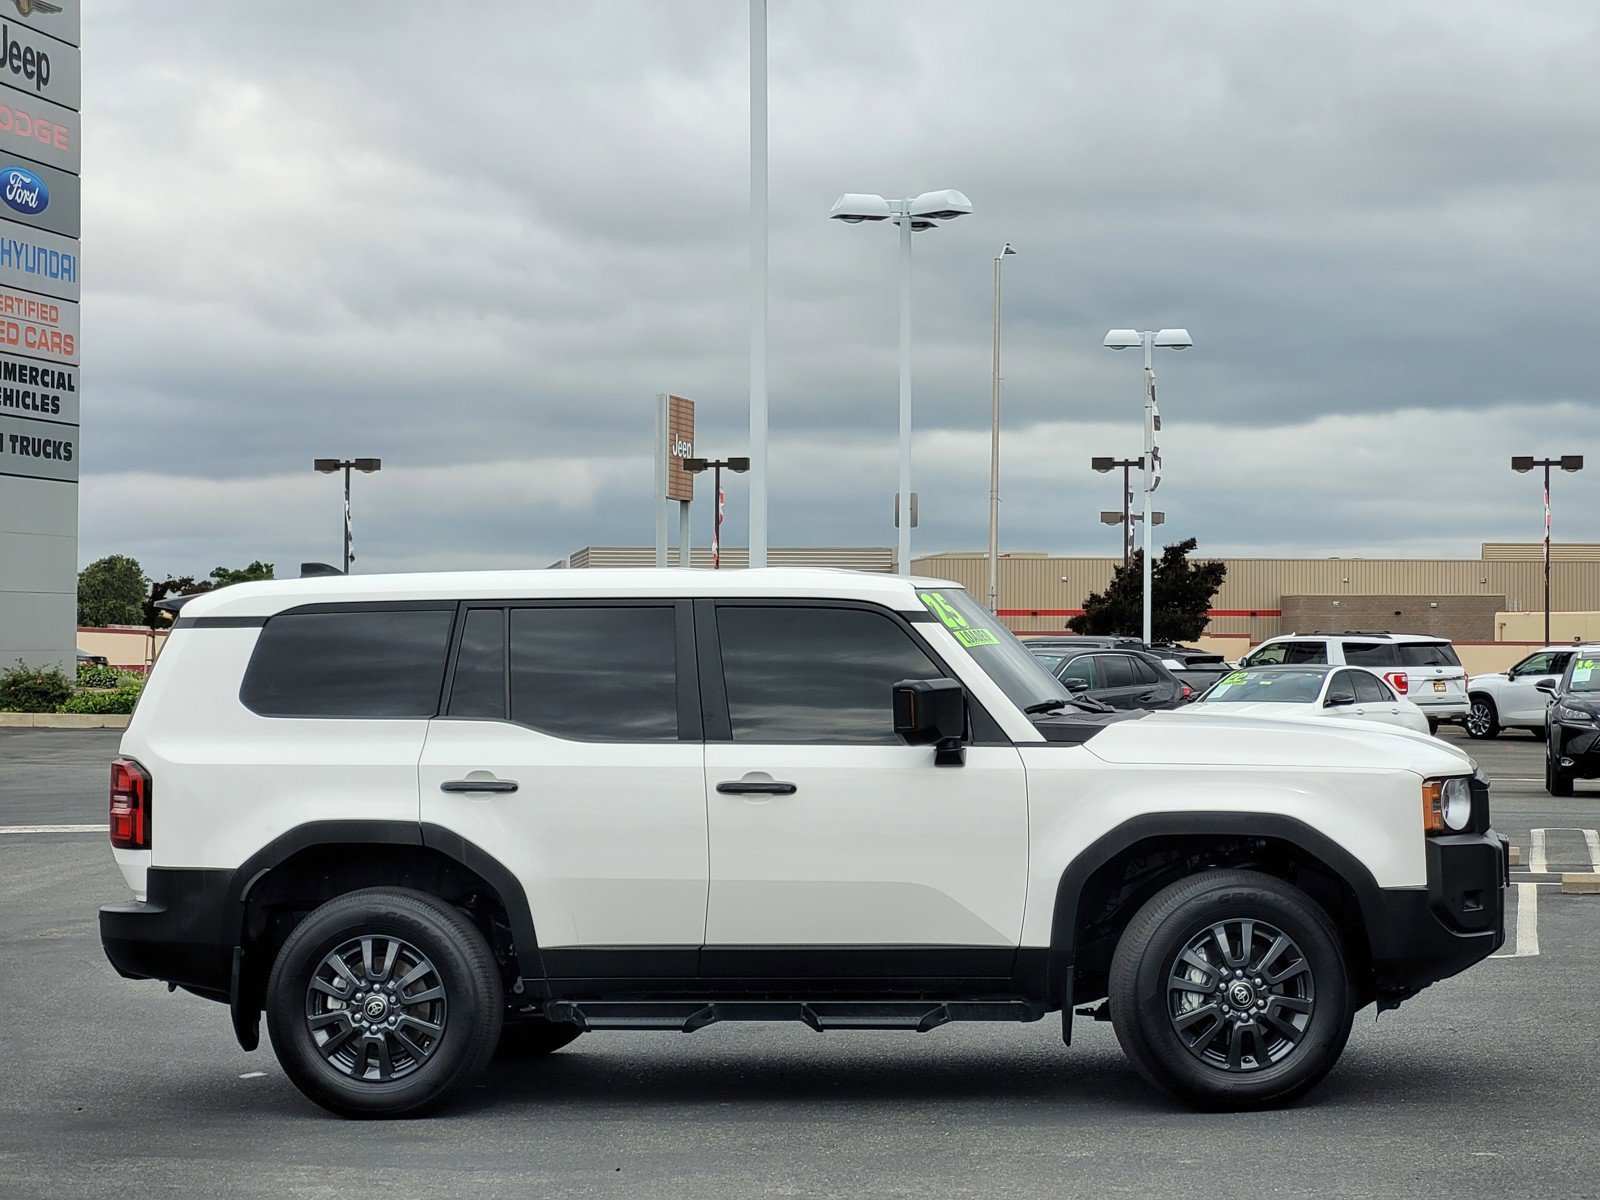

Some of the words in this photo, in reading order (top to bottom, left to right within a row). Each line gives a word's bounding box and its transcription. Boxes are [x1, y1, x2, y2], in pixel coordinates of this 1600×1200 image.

[0, 24, 51, 92] Jeep
[6, 171, 39, 209] Ford
[0, 237, 76, 284] HYUNDAI
[25, 326, 74, 356] CARS
[0, 361, 75, 392] MERCIAL
[0, 387, 60, 415] HICLES
[9, 434, 73, 462] TRUCKS
[920, 592, 969, 630] 25
